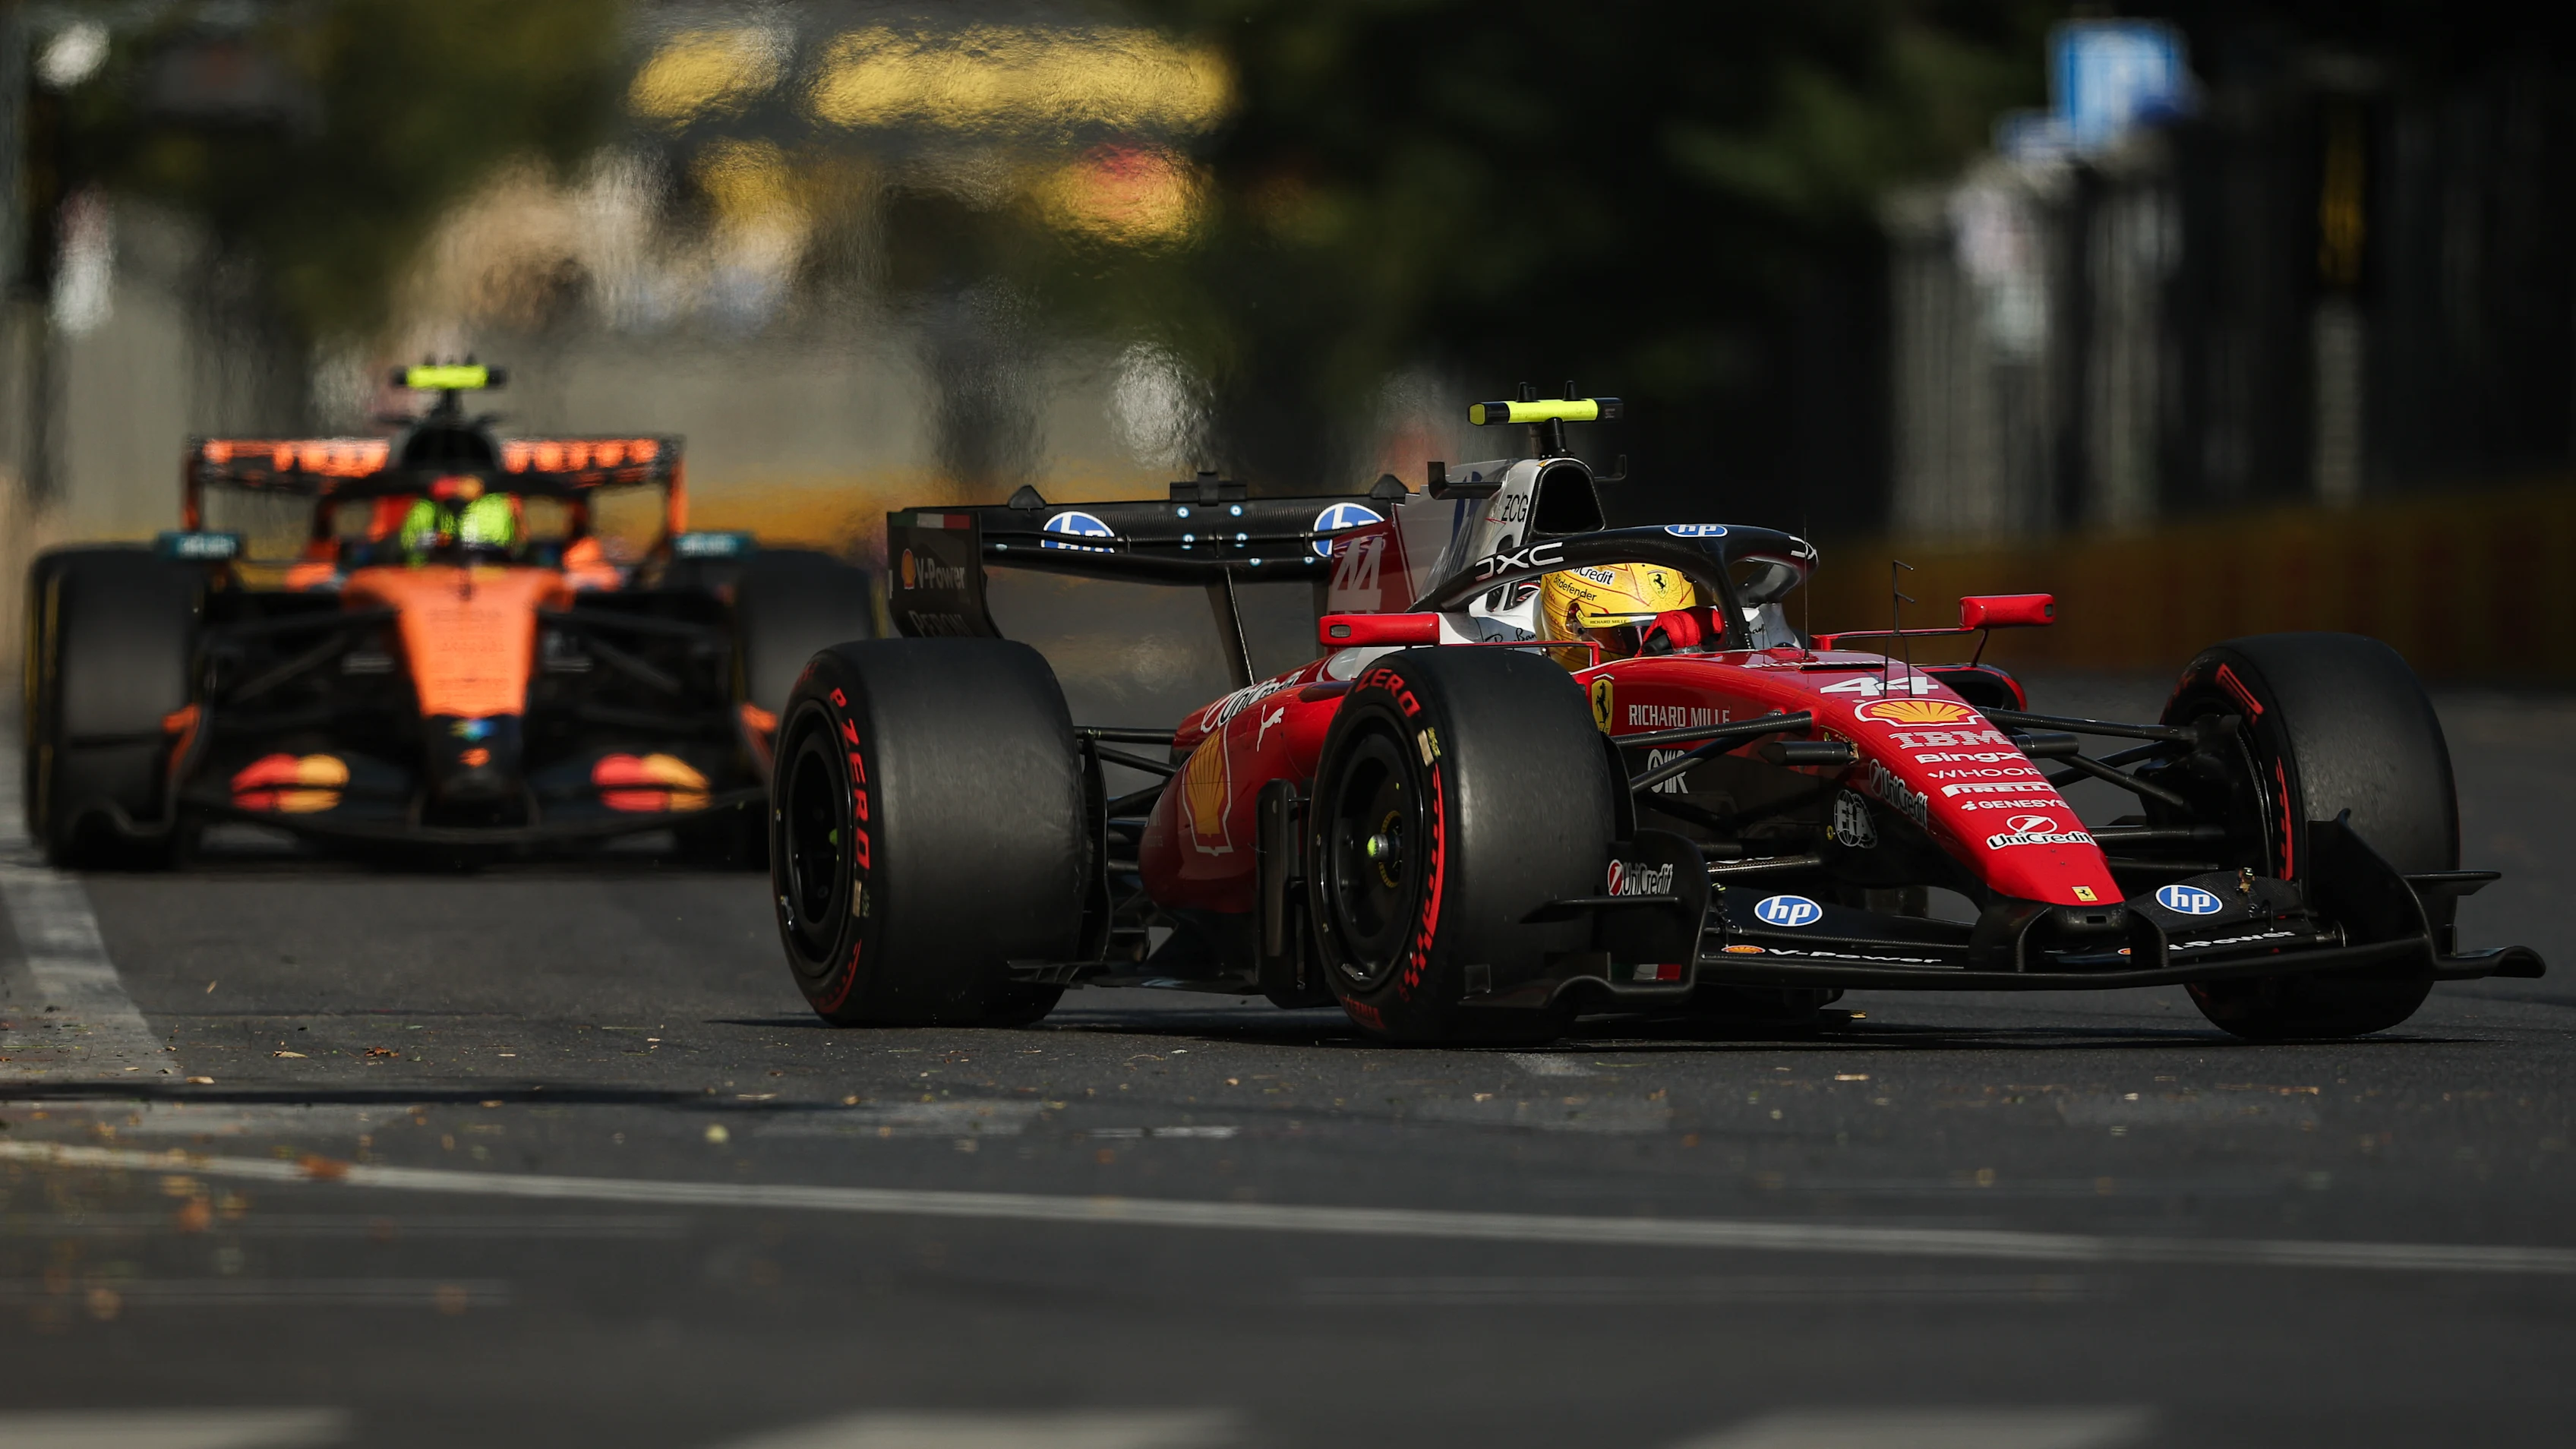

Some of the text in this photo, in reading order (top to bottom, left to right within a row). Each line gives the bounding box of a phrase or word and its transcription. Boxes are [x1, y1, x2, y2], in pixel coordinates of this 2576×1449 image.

[915, 557, 965, 589] V-Power
[1327, 536, 1383, 612] 44
[1475, 541, 1564, 582] DXC
[1554, 574, 1598, 602] Bitdefender
[1355, 668, 1422, 718] ZERO
[1820, 676, 1940, 696] 44
[1628, 704, 1687, 728] RICHARD
[1888, 730, 2016, 750] IBM
[841, 718, 870, 870] ZERO
[1978, 799, 2071, 811] GENESYS
[1986, 832, 2098, 849] UniCredit
[1622, 862, 1674, 895] UniCredit
[1767, 896, 1813, 926] hp
[2170, 886, 2211, 914] hp
[1768, 948, 1943, 964] V-Power
